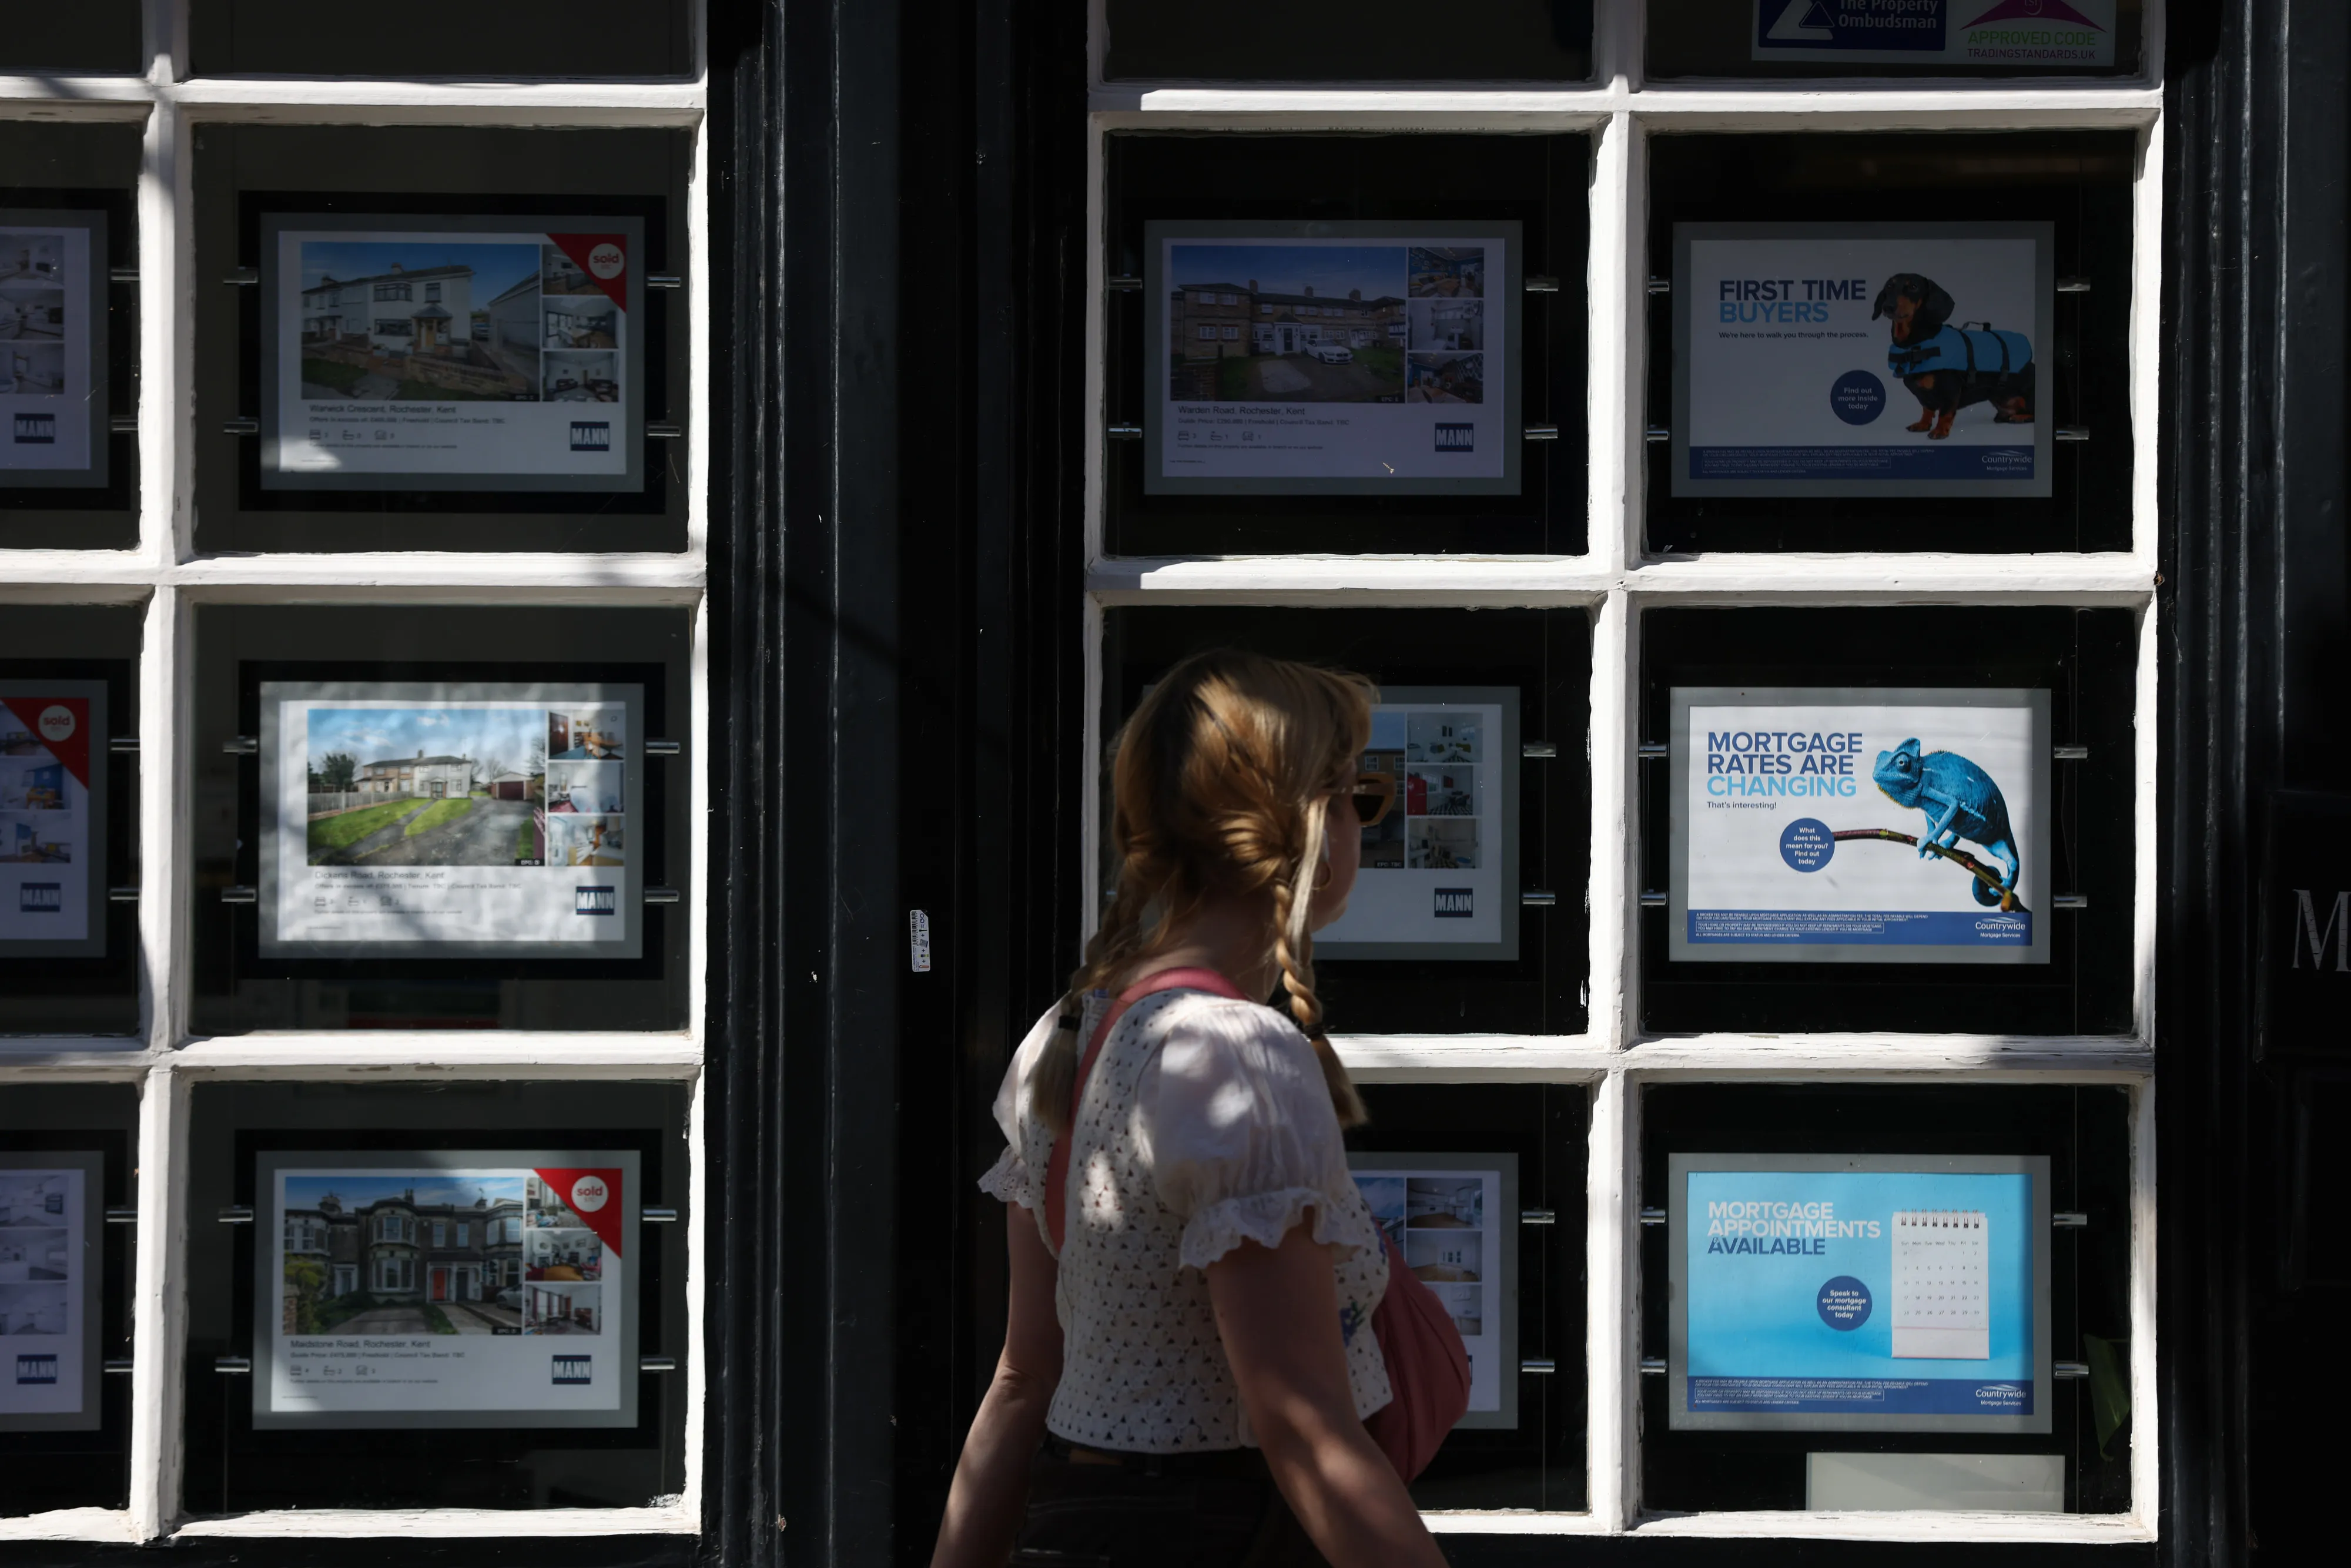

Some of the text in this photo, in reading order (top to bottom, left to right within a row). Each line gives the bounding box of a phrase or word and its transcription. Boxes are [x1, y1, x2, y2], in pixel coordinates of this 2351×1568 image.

[1840, 0, 1938, 15] The Property
[1838, 13, 1937, 29] Ombudsman
[1968, 31, 2097, 46] APPROVED CODE
[1967, 48, 2096, 60] TRADINGSTANDARDS.UK
[592, 253, 619, 264] sold
[1720, 279, 1866, 301] FIRST TIME
[1720, 302, 1829, 323] BUYERS
[1798, 331, 1826, 340] through
[1178, 406, 1210, 414] Warden
[1239, 406, 1284, 416] Rochester,
[1286, 407, 1305, 415] Kent
[1848, 403, 1869, 411] today
[16, 419, 54, 437] MANN
[572, 427, 609, 445] MANN
[1435, 428, 1473, 447] MANN
[1981, 455, 2032, 465] Countrywide
[43, 715, 71, 726] sold
[1708, 732, 1863, 753] MORTGAGE
[1707, 753, 1854, 775] RATES ARE
[1707, 775, 1856, 797] CHANGING
[1733, 801, 1777, 810] interesting!
[424, 872, 446, 880] Kent
[22, 889, 61, 906] MANN
[577, 892, 614, 910] MANN
[1435, 894, 1472, 912] MANN
[1975, 921, 2026, 932] Countrywide
[577, 1185, 604, 1197] sold
[1709, 1201, 1833, 1219] MORTGAGE
[1707, 1219, 1881, 1238] APPOINTMENTS
[1707, 1238, 1826, 1255] AVAILABLE
[1830, 1289, 1850, 1298] Speak
[1834, 1297, 1867, 1305] mortgage
[1834, 1311, 1854, 1319] today
[290, 1340, 334, 1348] Maidstone
[18, 1361, 56, 1378] MANN
[553, 1361, 590, 1379] MANN
[1975, 1389, 2027, 1399] Countrywide
